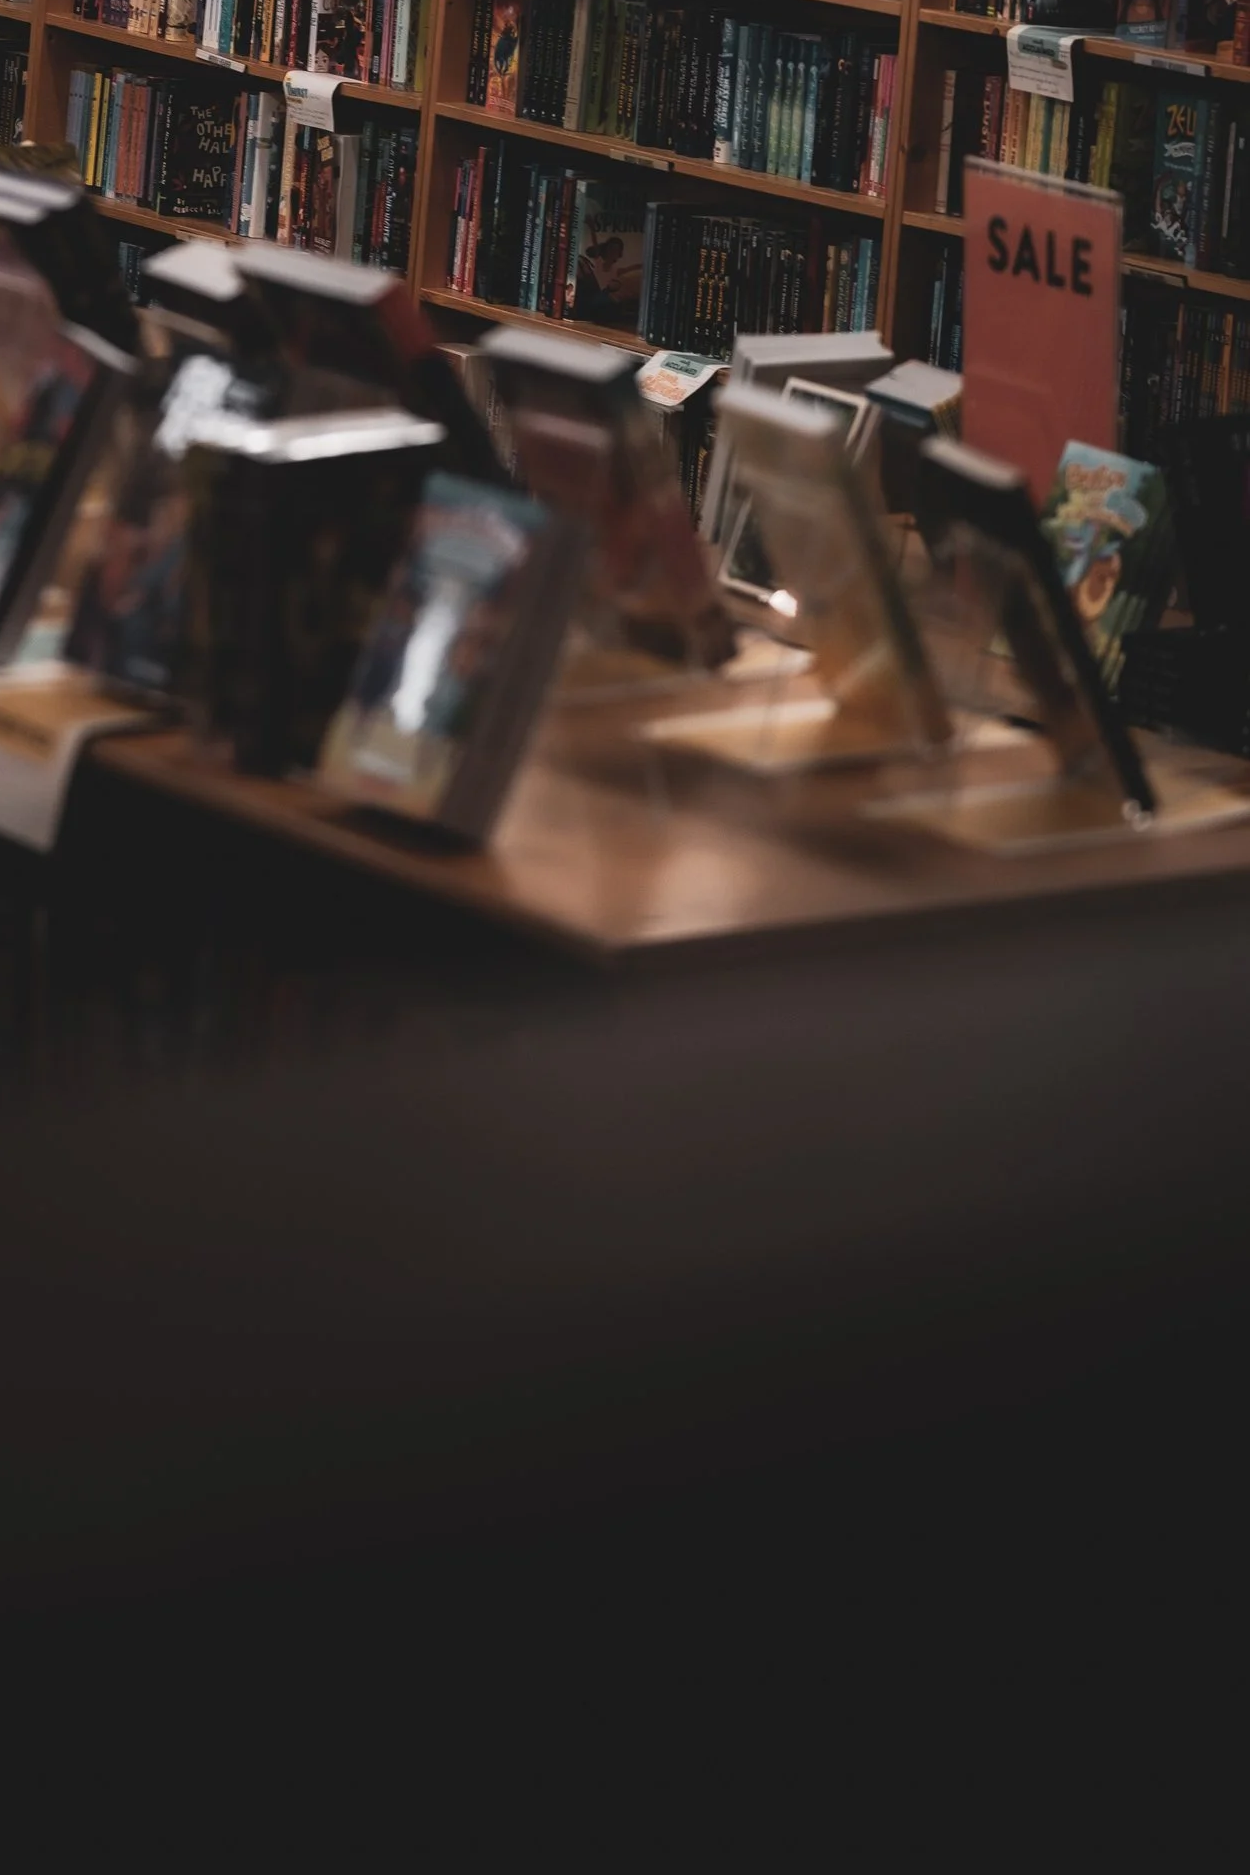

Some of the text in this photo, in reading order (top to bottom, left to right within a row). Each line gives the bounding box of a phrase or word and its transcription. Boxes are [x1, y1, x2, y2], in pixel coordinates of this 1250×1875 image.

[190, 105, 213, 121] THE
[720, 101, 729, 129] GREAT
[196, 119, 233, 139] OTHE
[197, 135, 230, 155] HAL
[520, 213, 532, 283] PUDDING PROBLEM
[987, 215, 1094, 296] SALE
